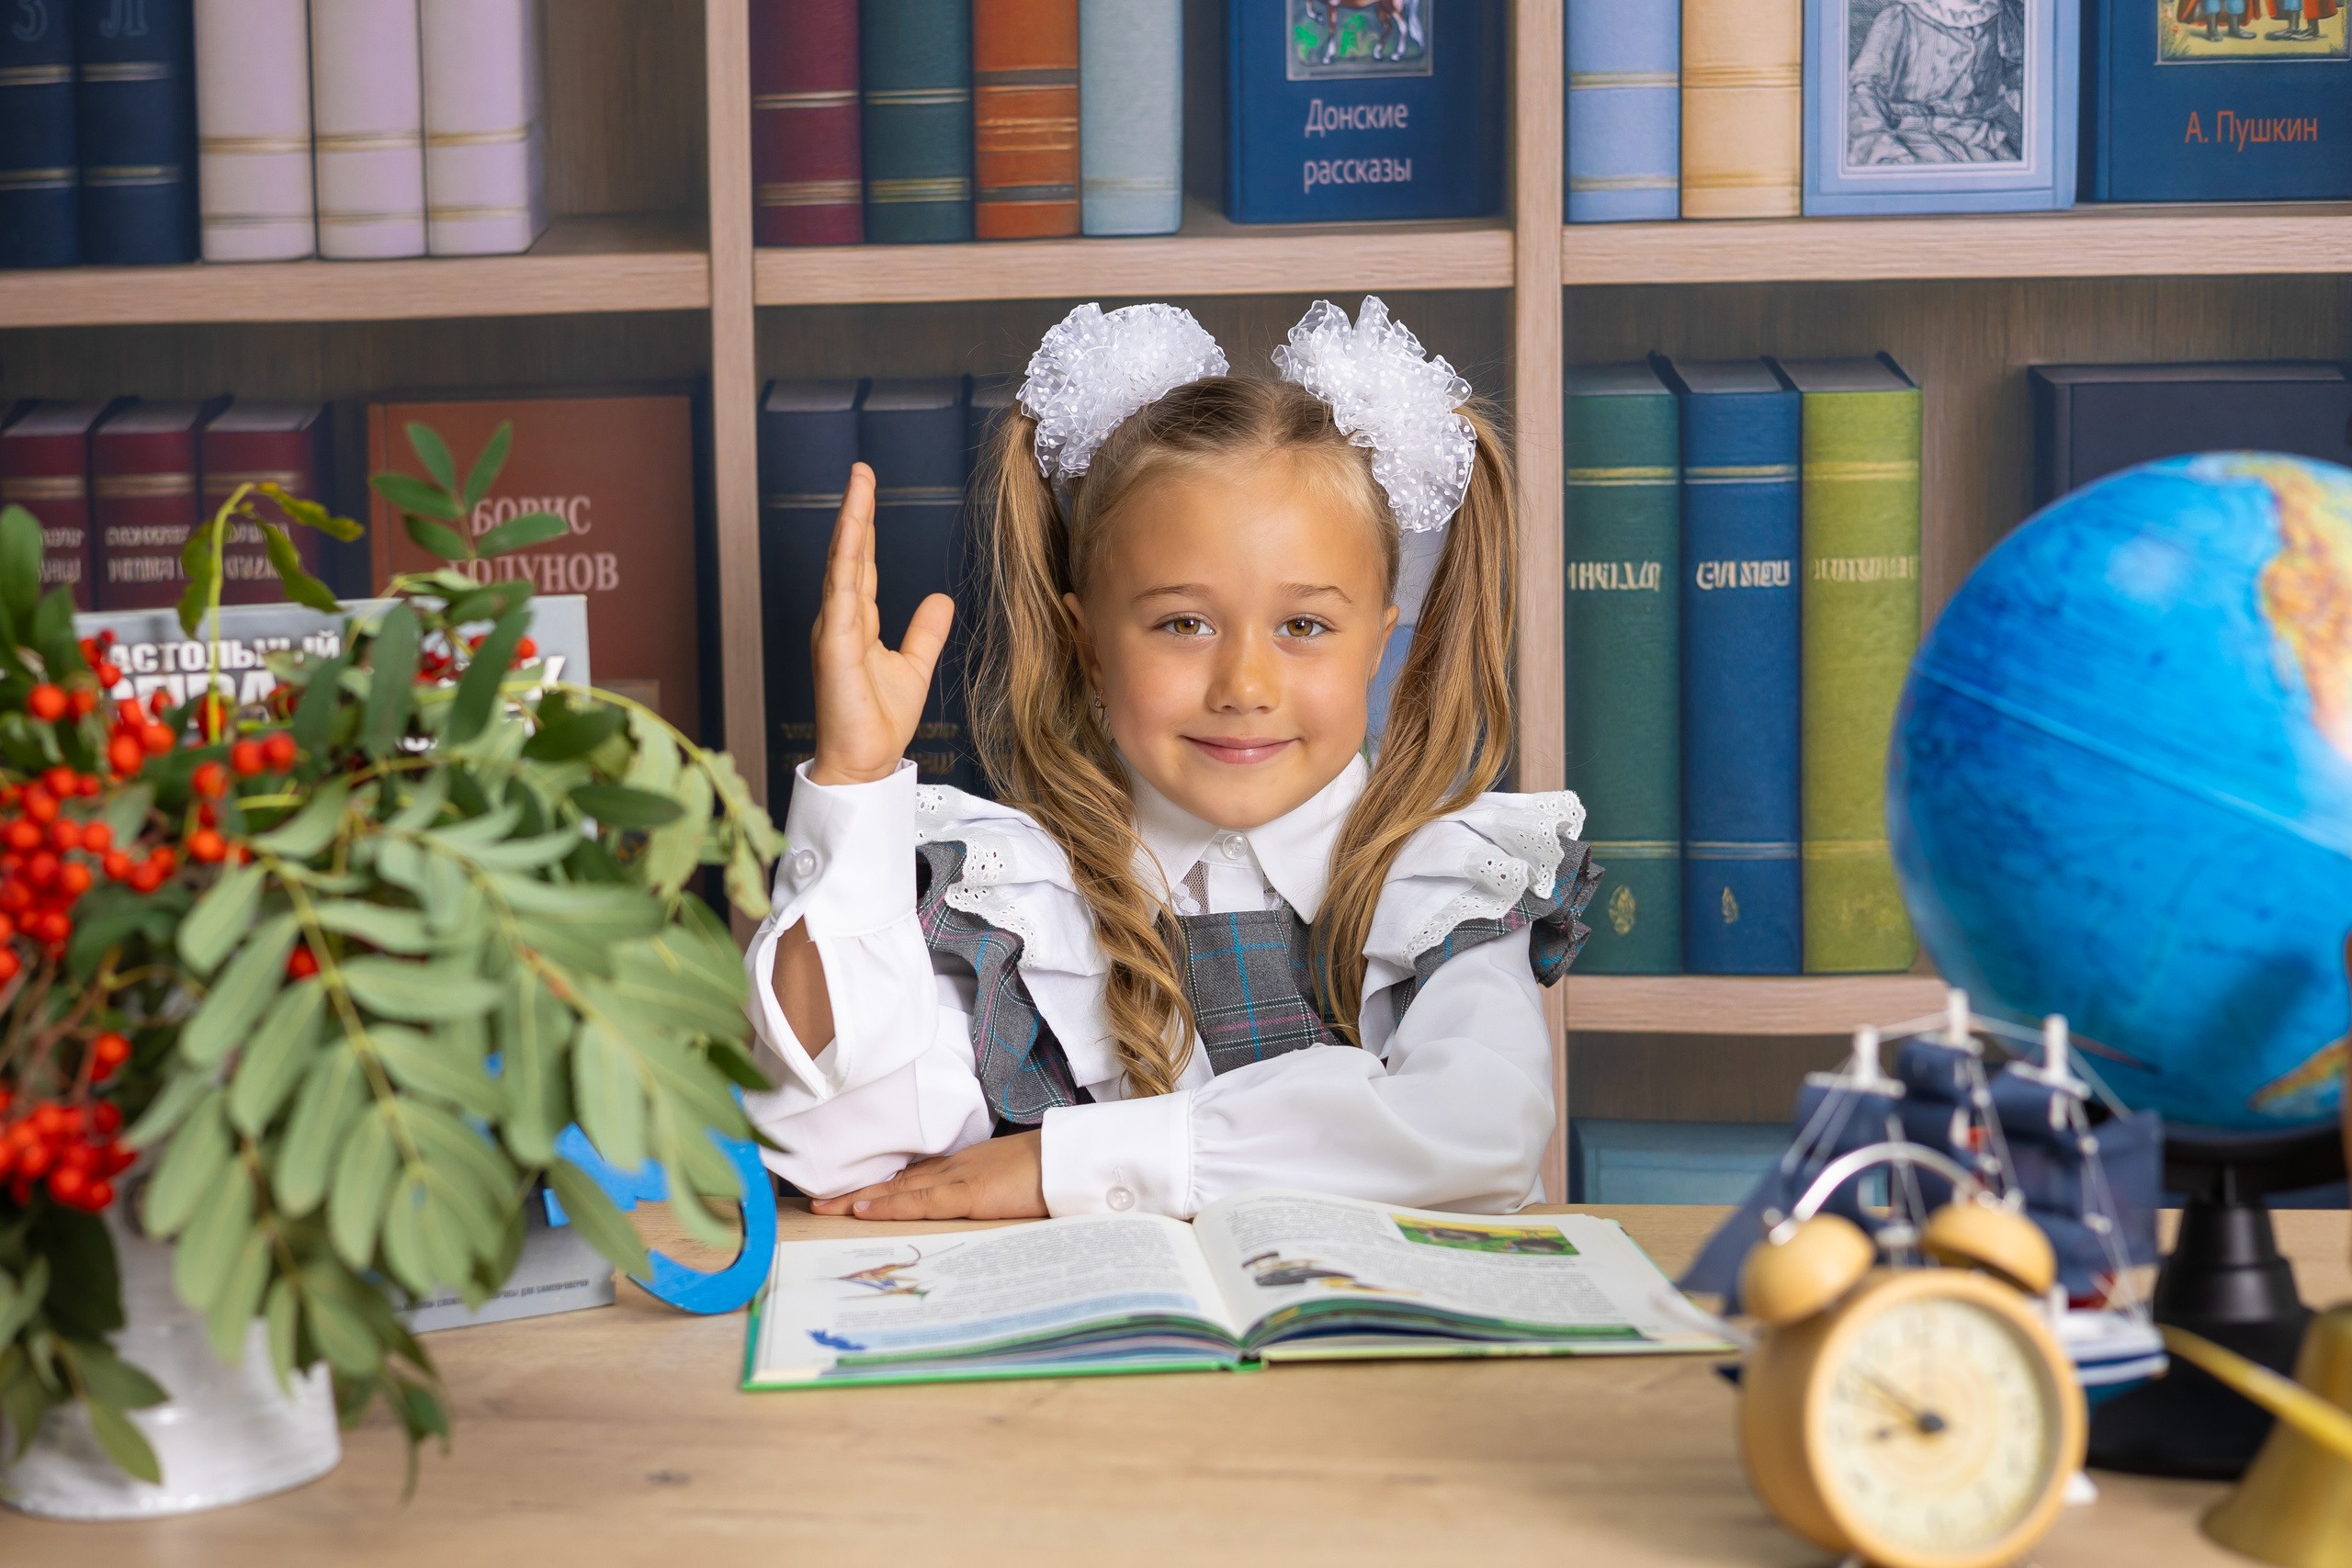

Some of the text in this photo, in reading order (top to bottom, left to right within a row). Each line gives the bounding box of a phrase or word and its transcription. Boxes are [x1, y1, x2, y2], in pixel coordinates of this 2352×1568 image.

[1305, 97, 1409, 139] Донские
[2184, 110, 2318, 153] А. Пушкин
[1304, 157, 1412, 195] рассказы
[447, 552, 620, 592] ОДУНОВ
